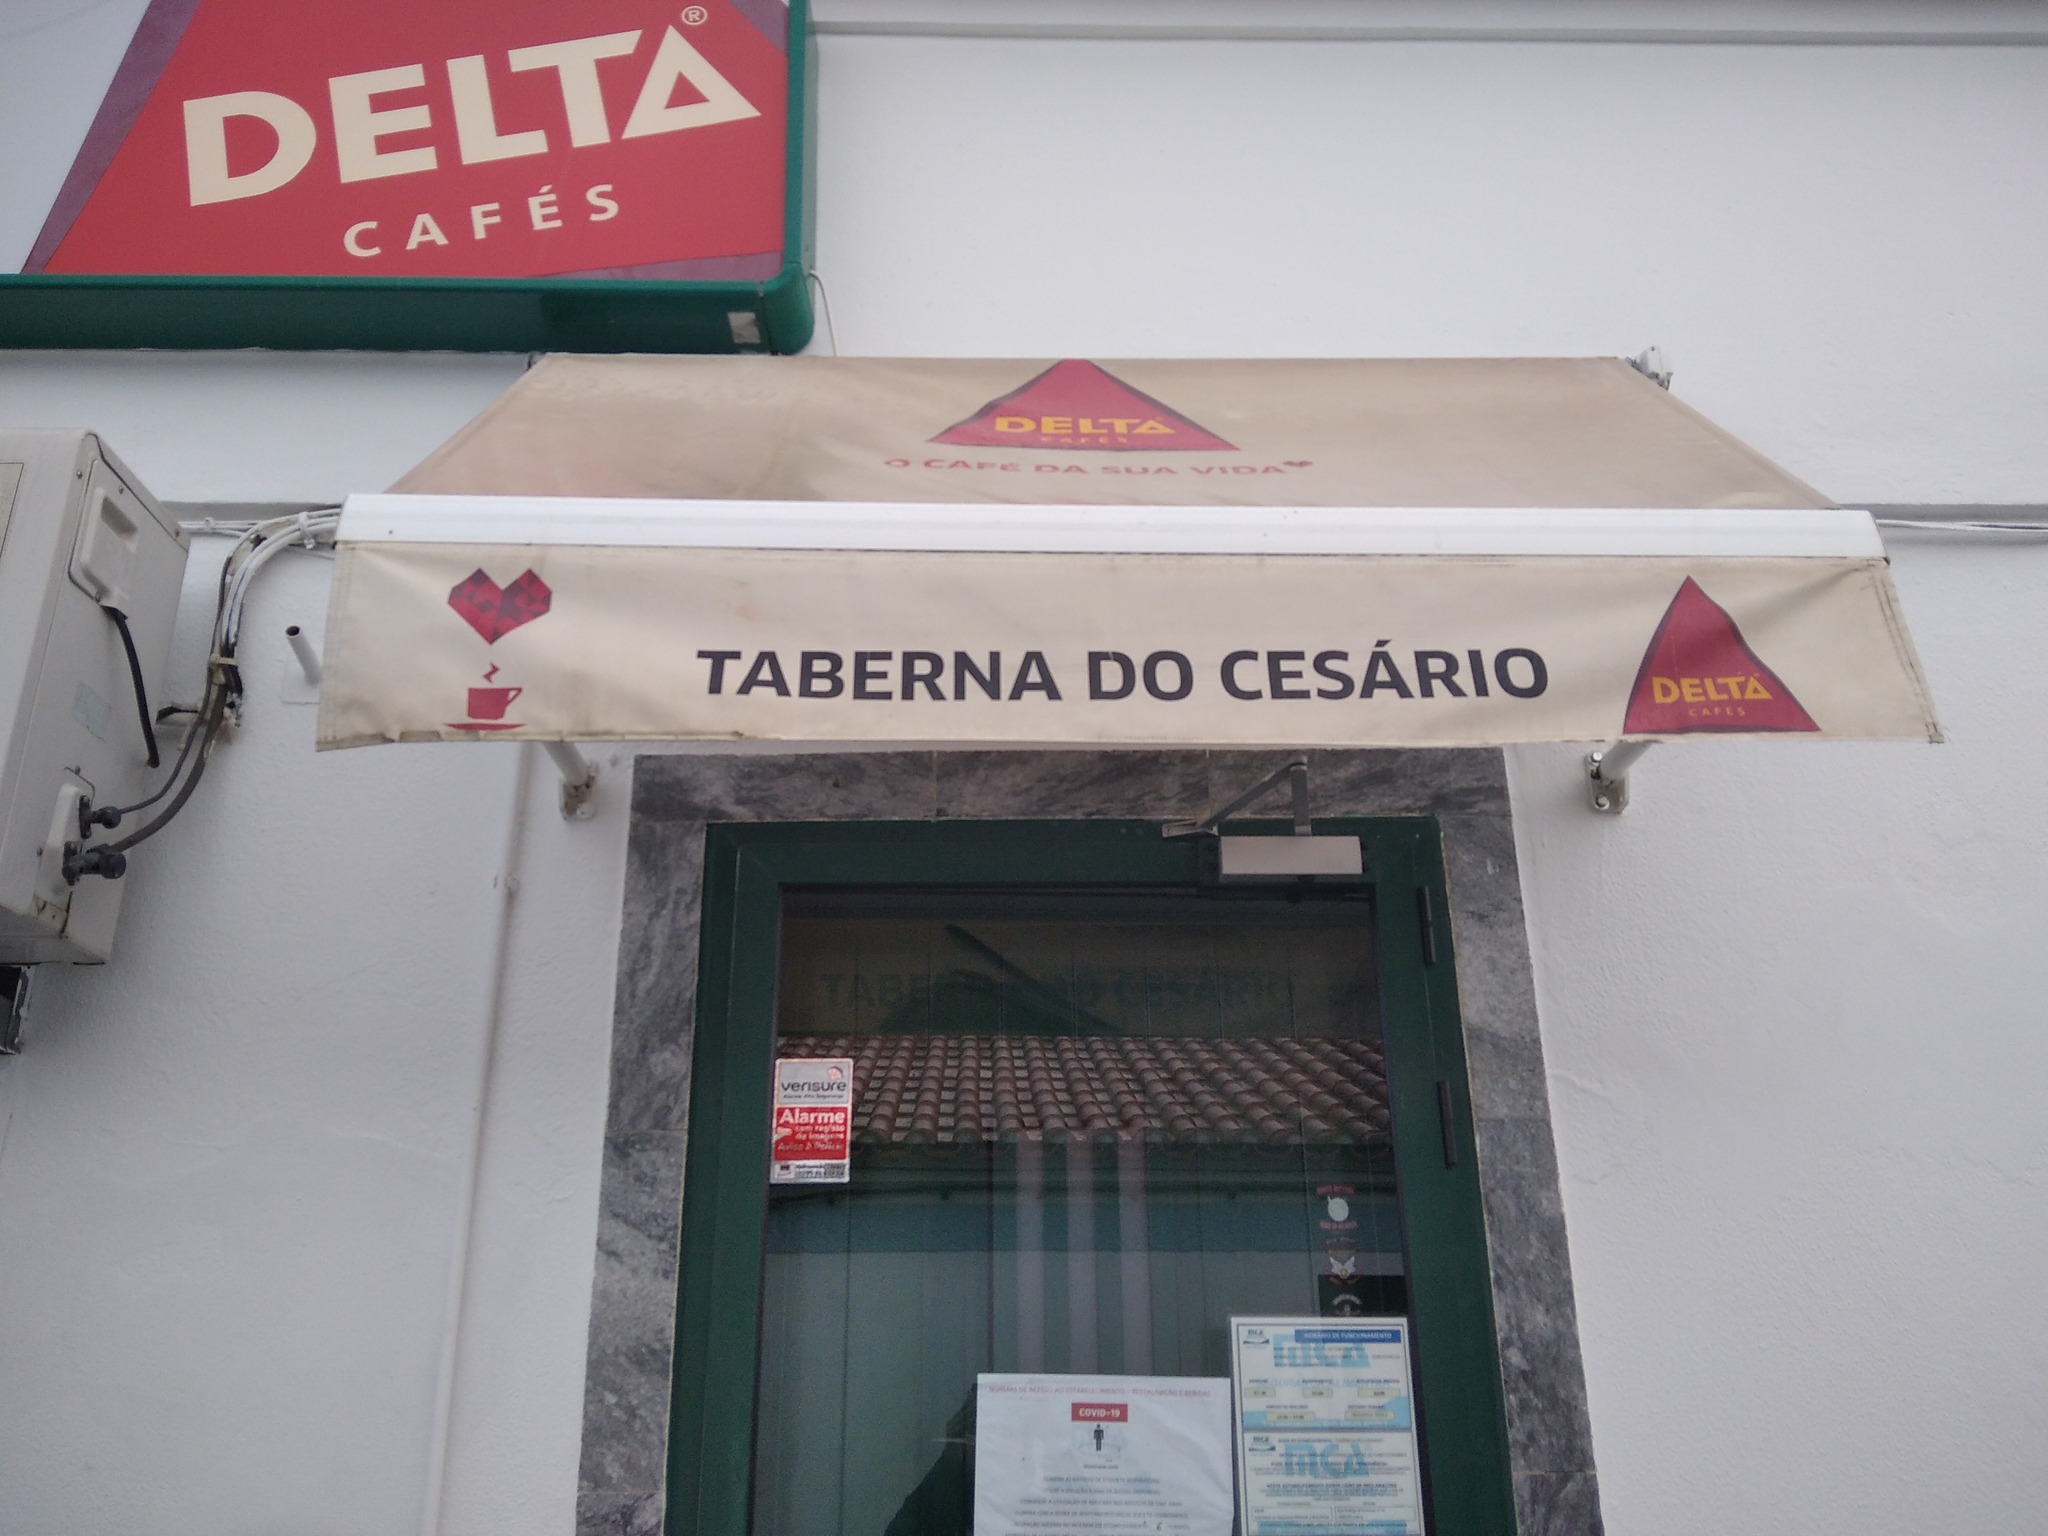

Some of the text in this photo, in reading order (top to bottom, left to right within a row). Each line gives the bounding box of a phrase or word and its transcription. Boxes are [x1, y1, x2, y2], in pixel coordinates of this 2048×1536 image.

[182, 25, 761, 207] DELTA
[343, 184, 620, 257] CAFÉS
[994, 416, 1176, 435] DELTA
[884, 459, 910, 468] O
[1035, 464, 1089, 474] DA
[1101, 466, 1178, 475] SUA
[1190, 466, 1286, 475] VIDA
[696, 639, 1550, 702] TABERNA DO CESÁRIO
[1652, 675, 1773, 704] DELTA
[780, 1081, 847, 1092] verisure
[780, 1108, 845, 1124] Alarme
[1078, 1407, 1121, 1418] COVID-19
